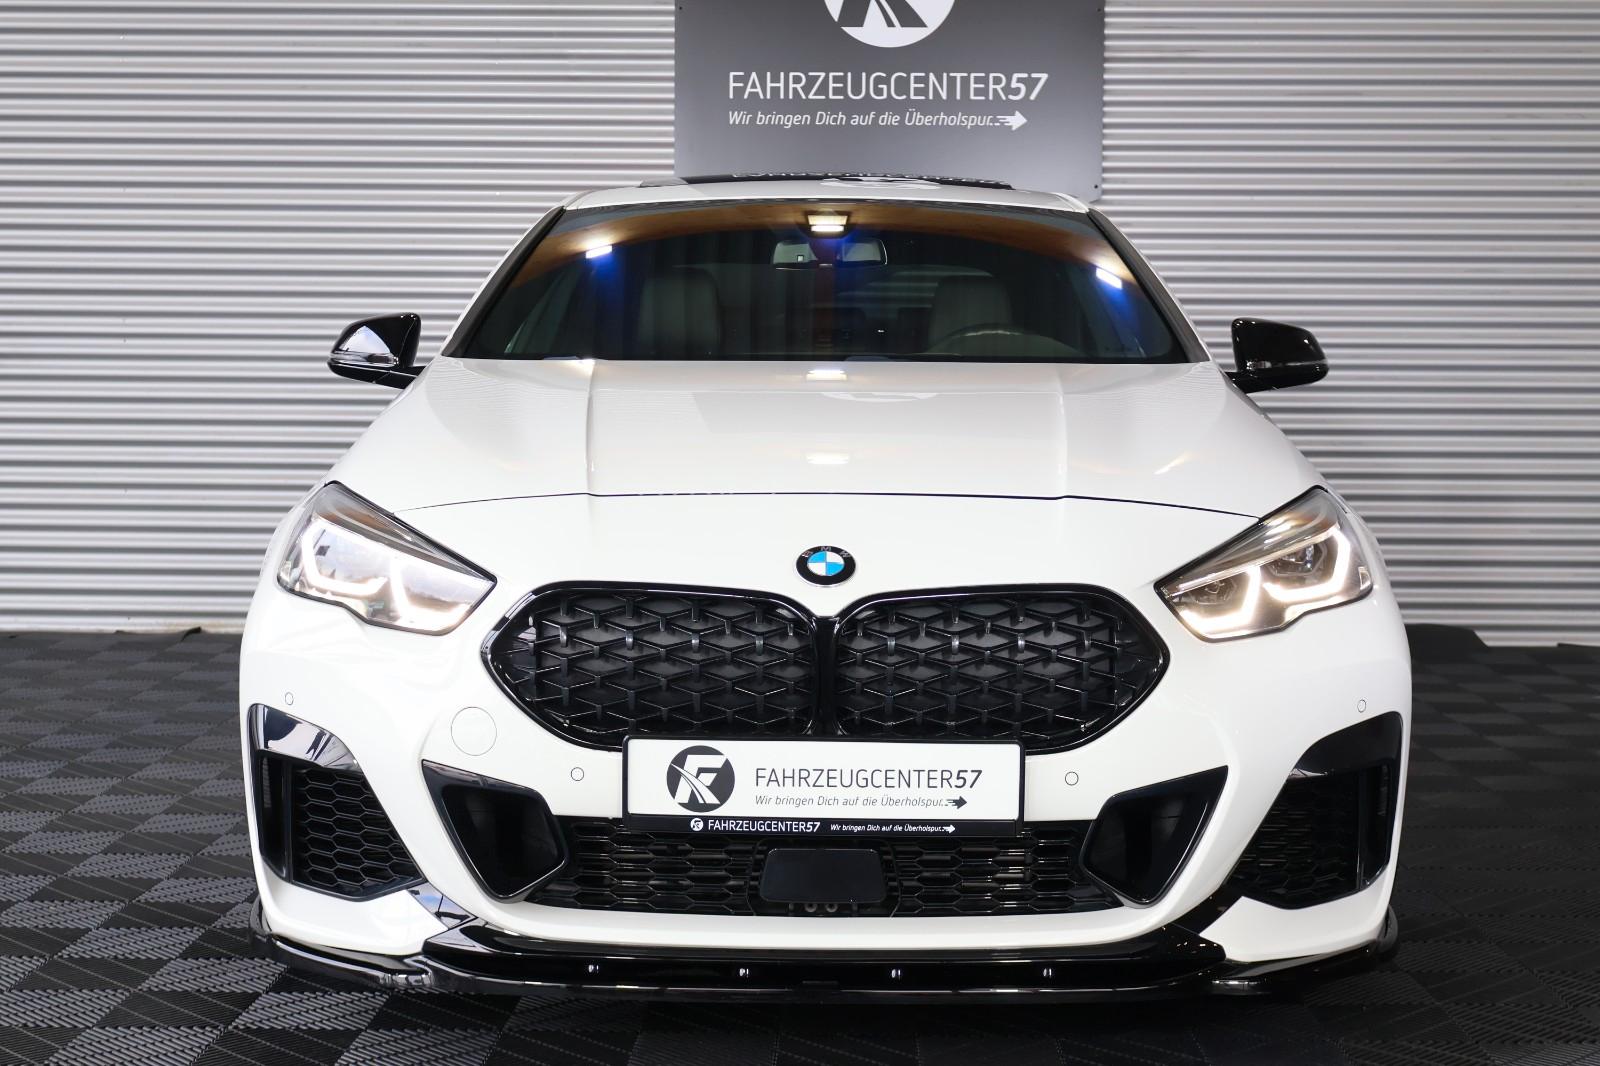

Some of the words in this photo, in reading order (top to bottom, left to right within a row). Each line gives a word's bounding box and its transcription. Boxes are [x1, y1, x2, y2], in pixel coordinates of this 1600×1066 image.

[729, 71, 1049, 101] FAHRZEUGCENTER57
[728, 111, 752, 125] Wir
[756, 111, 811, 129] bringen
[815, 111, 847, 126] Dich
[850, 111, 876, 126] auf
[878, 111, 901, 126] die
[755, 768, 983, 789] FAHRZEUGCENTER57
[755, 795, 772, 806] Wir
[775, 795, 814, 808] bringen
[817, 796, 839, 806] Dich
[842, 796, 860, 807] auf
[862, 796, 878, 807] die
[708, 819, 821, 833] FAHRZEUGCENTER57
[830, 823, 841, 831] Wir
[842, 823, 865, 833] bringen
[867, 824, 880, 832] Dich
[881, 824, 893, 832] auf
[893, 824, 903, 832] die
